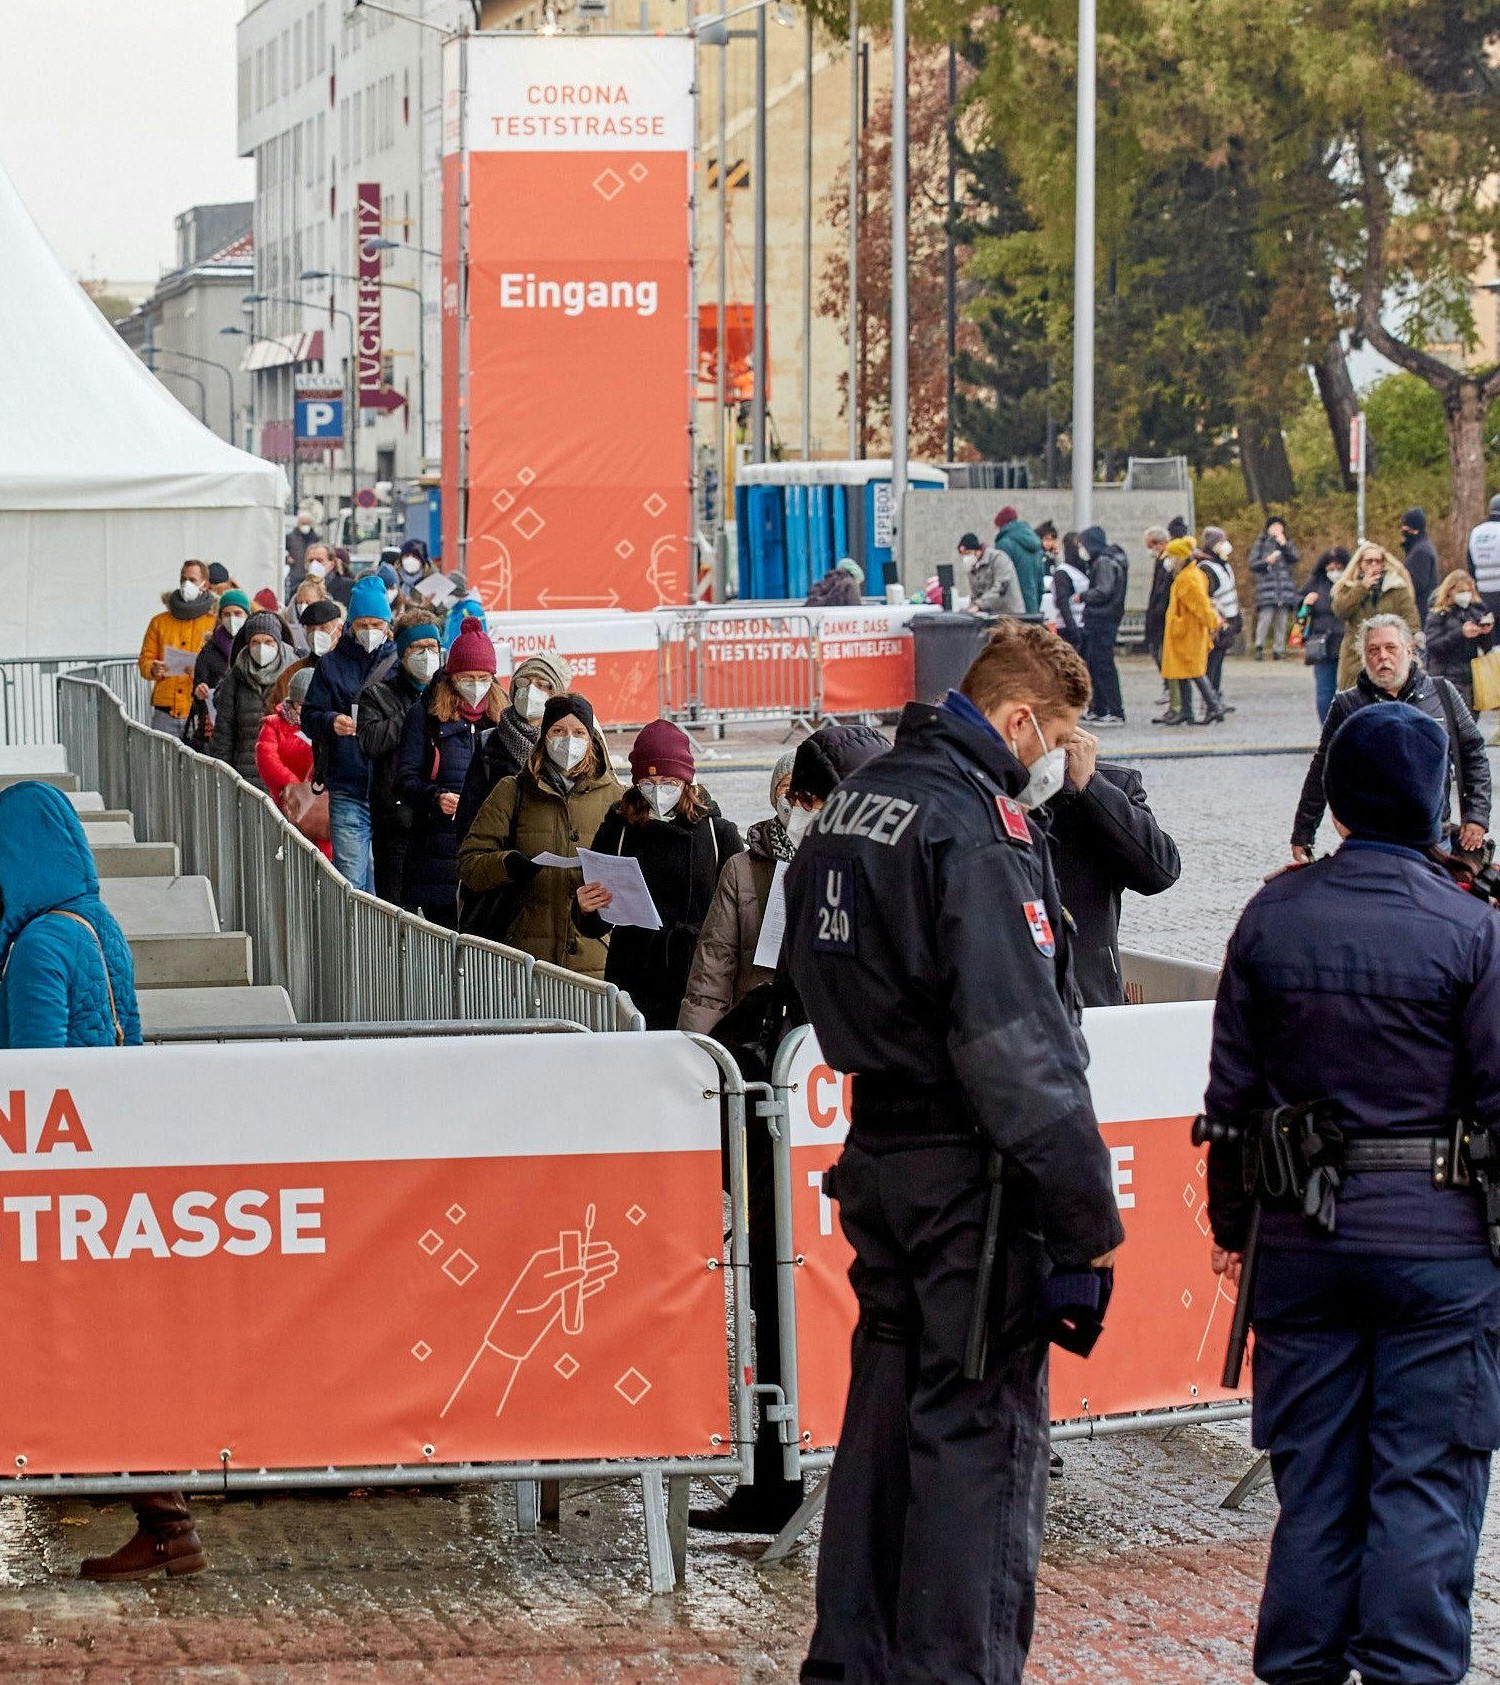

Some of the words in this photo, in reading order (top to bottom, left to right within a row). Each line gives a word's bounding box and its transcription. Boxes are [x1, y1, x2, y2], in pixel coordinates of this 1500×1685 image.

[526, 85, 630, 105] CORONA
[491, 116, 666, 136] TESTSTRASSE
[500, 273, 658, 316] Eingang
[359, 275, 381, 391] LUGNER
[306, 403, 335, 436] P
[877, 486, 891, 545] PIPIBOX
[822, 620, 861, 636] DANKE,
[862, 618, 890, 634] DASS
[823, 642, 841, 660] SIE
[826, 869, 842, 907] U
[818, 906, 850, 943] 240
